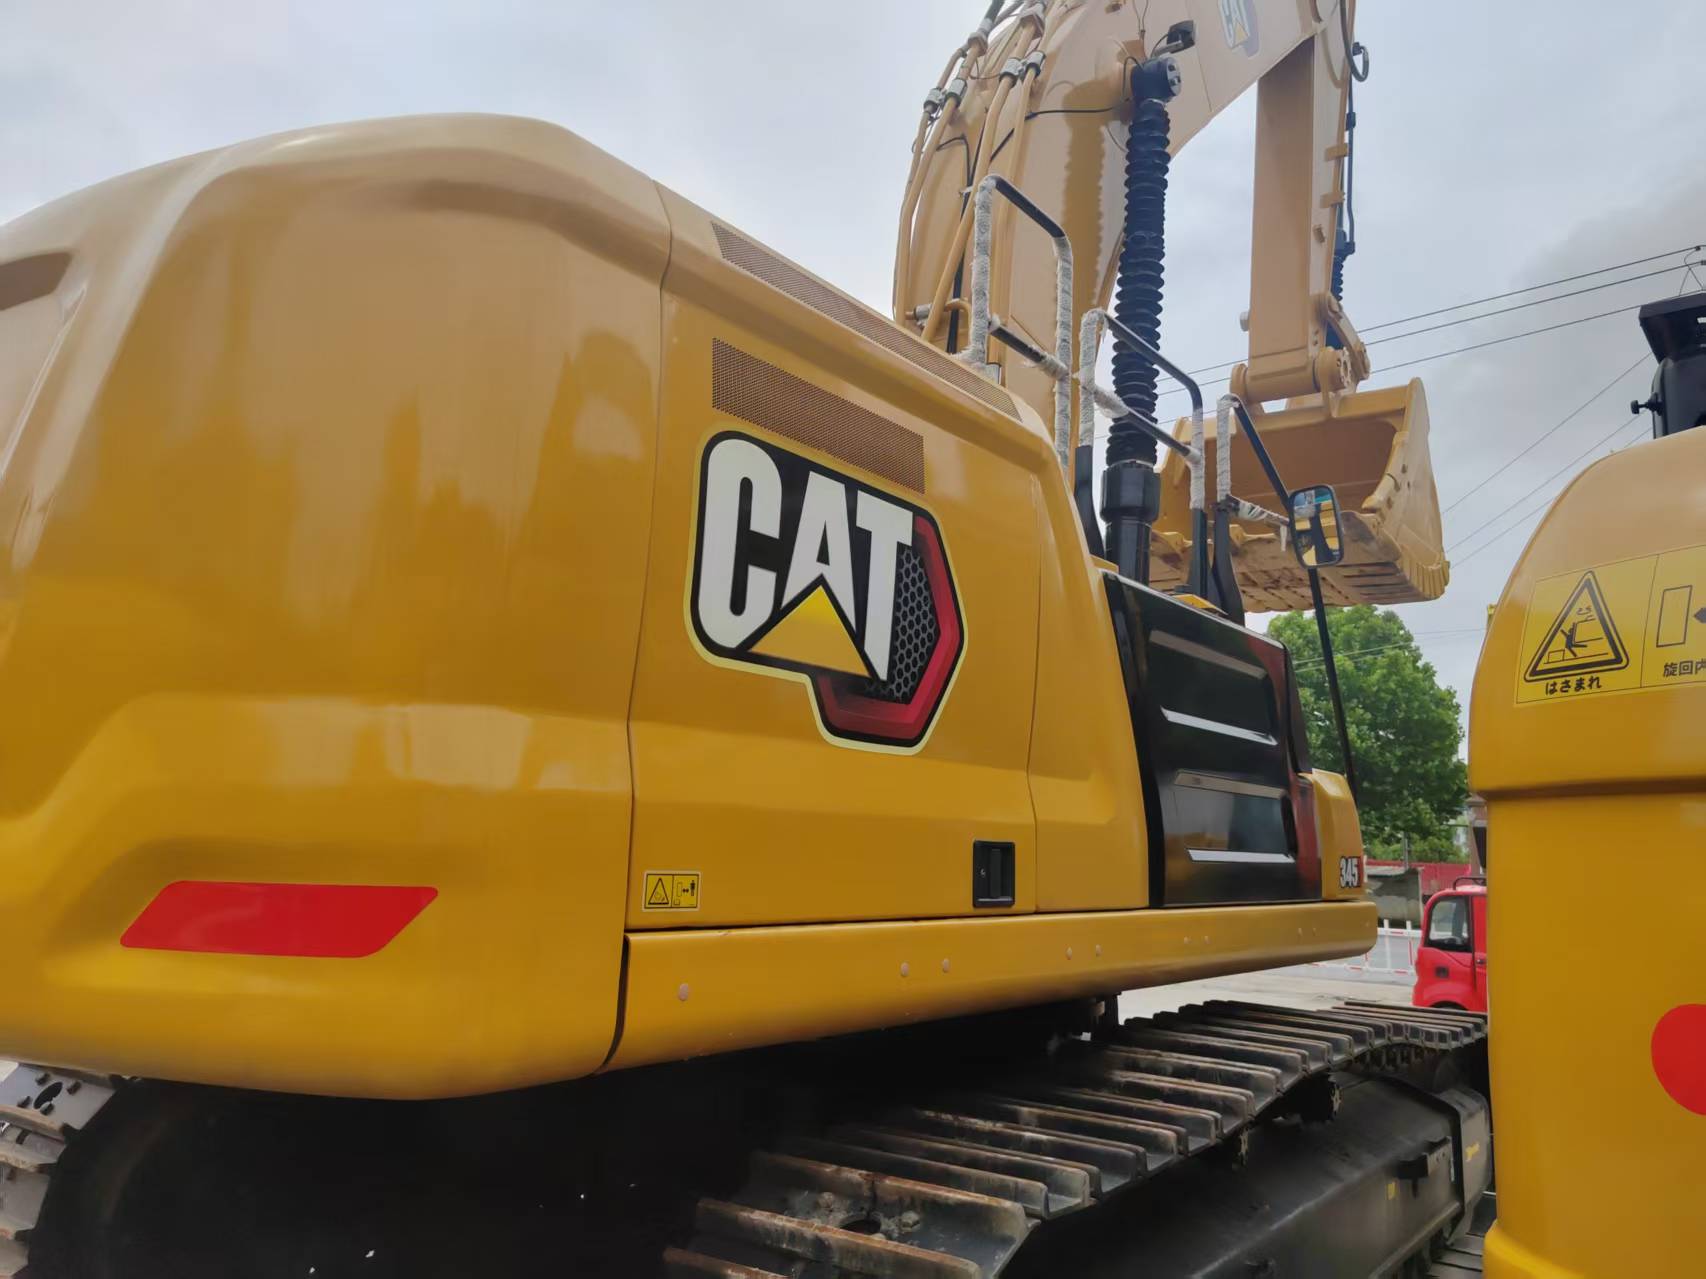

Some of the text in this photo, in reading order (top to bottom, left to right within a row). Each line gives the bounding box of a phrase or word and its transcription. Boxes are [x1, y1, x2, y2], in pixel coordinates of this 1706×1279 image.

[698, 439, 913, 681] CAT
[1545, 676, 1602, 695] はさまれ
[1340, 857, 1358, 887] 345
